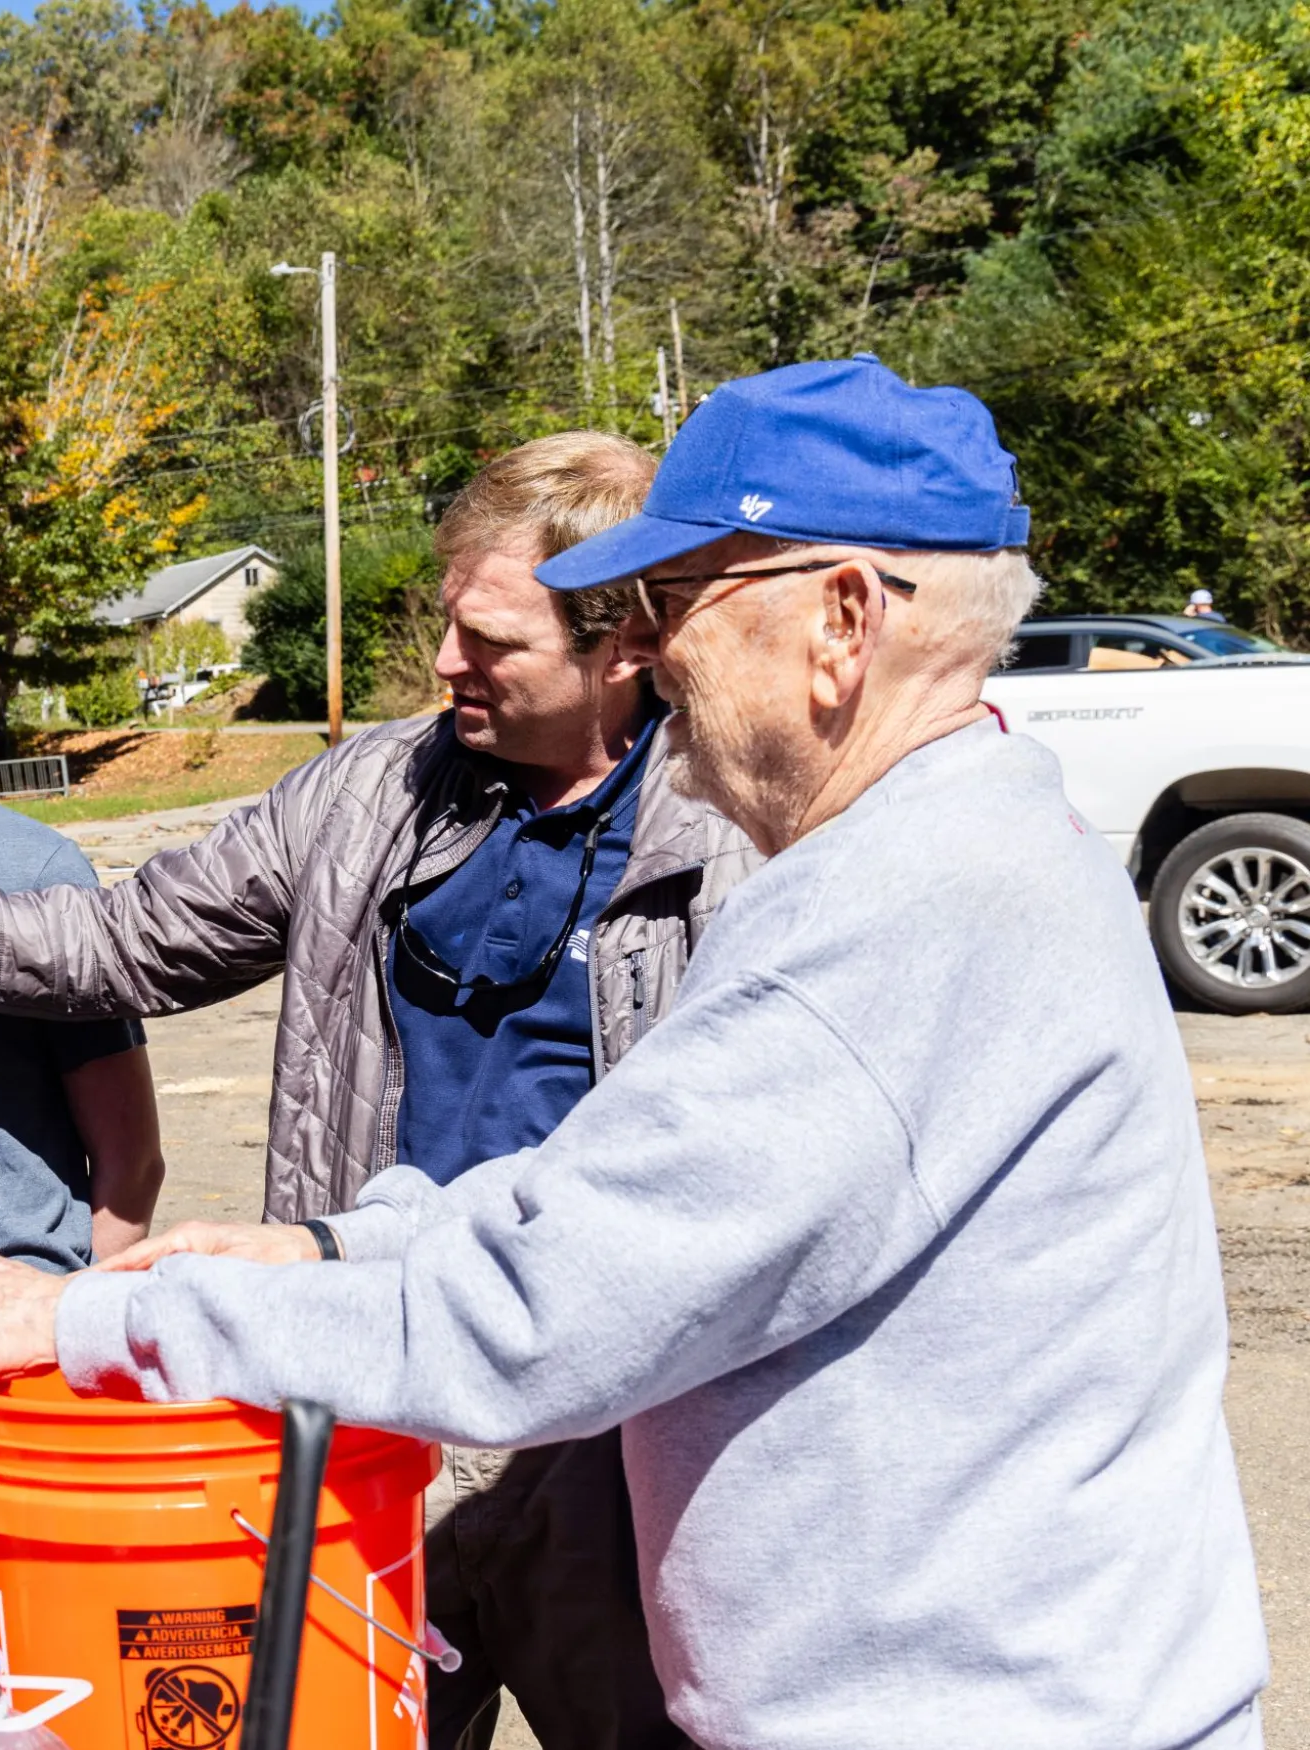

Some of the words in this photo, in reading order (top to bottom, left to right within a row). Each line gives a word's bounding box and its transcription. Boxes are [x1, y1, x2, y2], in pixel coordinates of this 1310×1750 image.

[1027, 706, 1144, 722] SPORT
[161, 1610, 226, 1625] WARNING
[150, 1626, 241, 1641] ADVERTENCIA
[143, 1642, 250, 1658] AVERTISSEMENT
